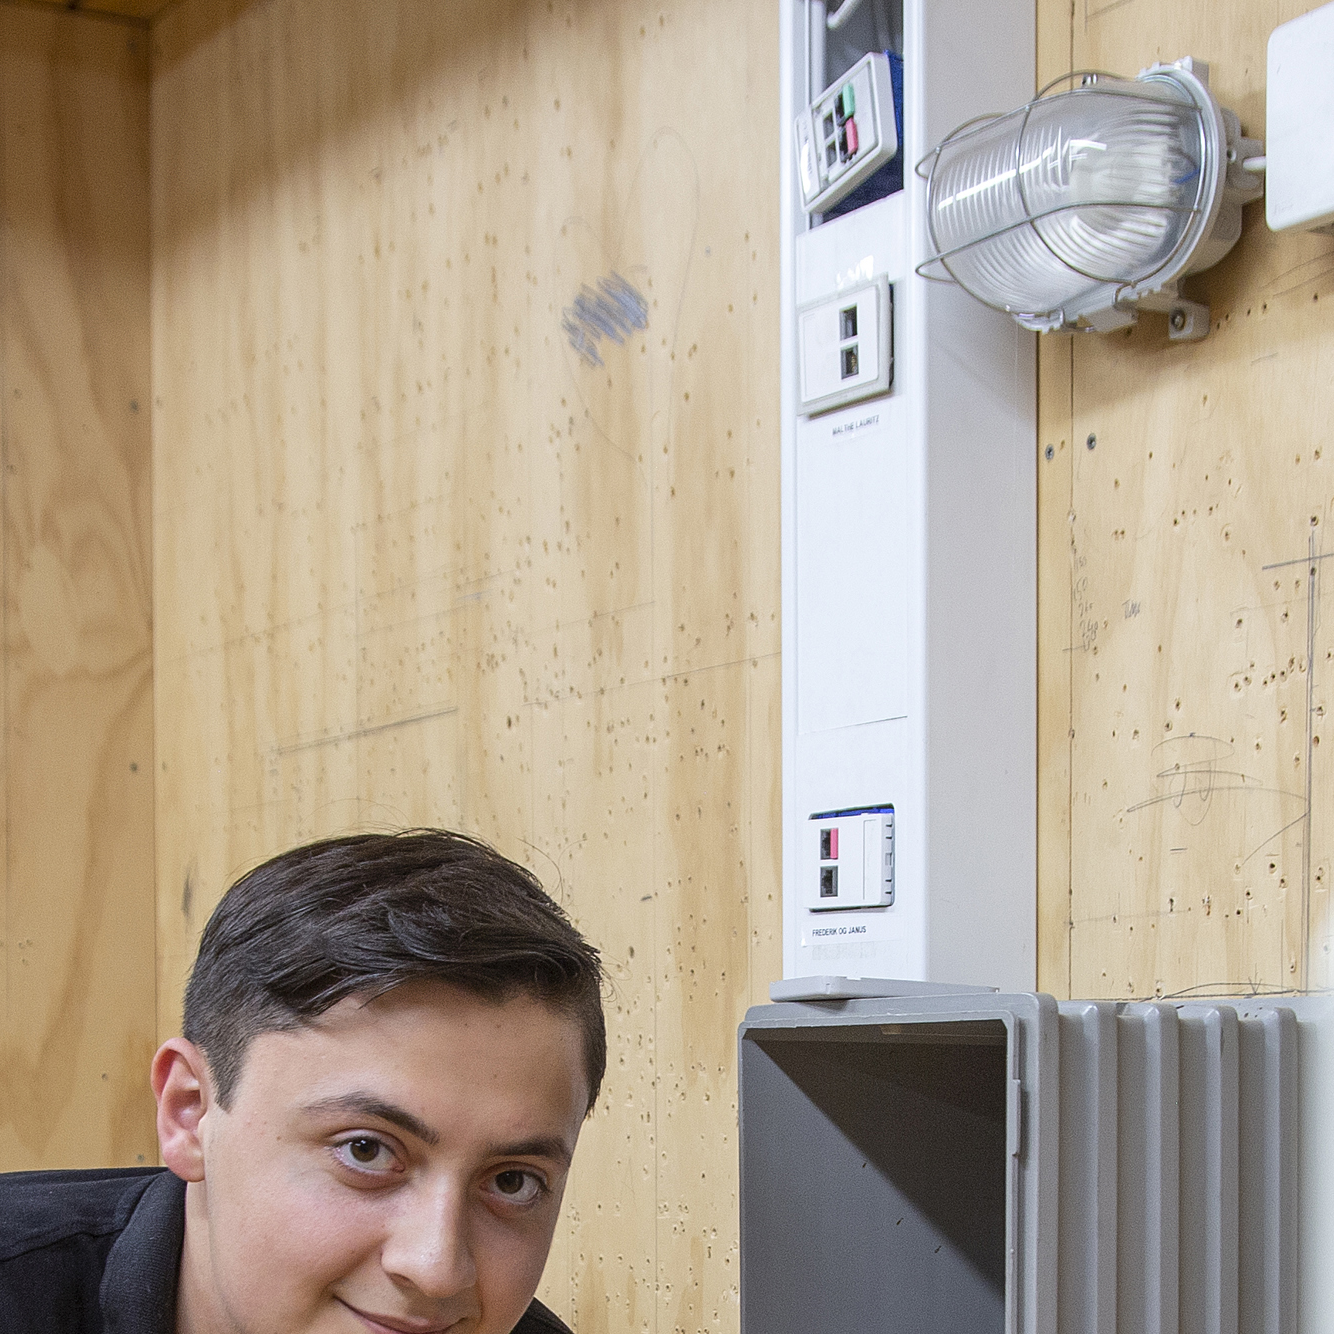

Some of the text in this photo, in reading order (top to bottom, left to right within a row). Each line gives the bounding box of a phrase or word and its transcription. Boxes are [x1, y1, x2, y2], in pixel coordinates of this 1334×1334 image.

[812, 926, 867, 937] FREDERIK OG JANUS
